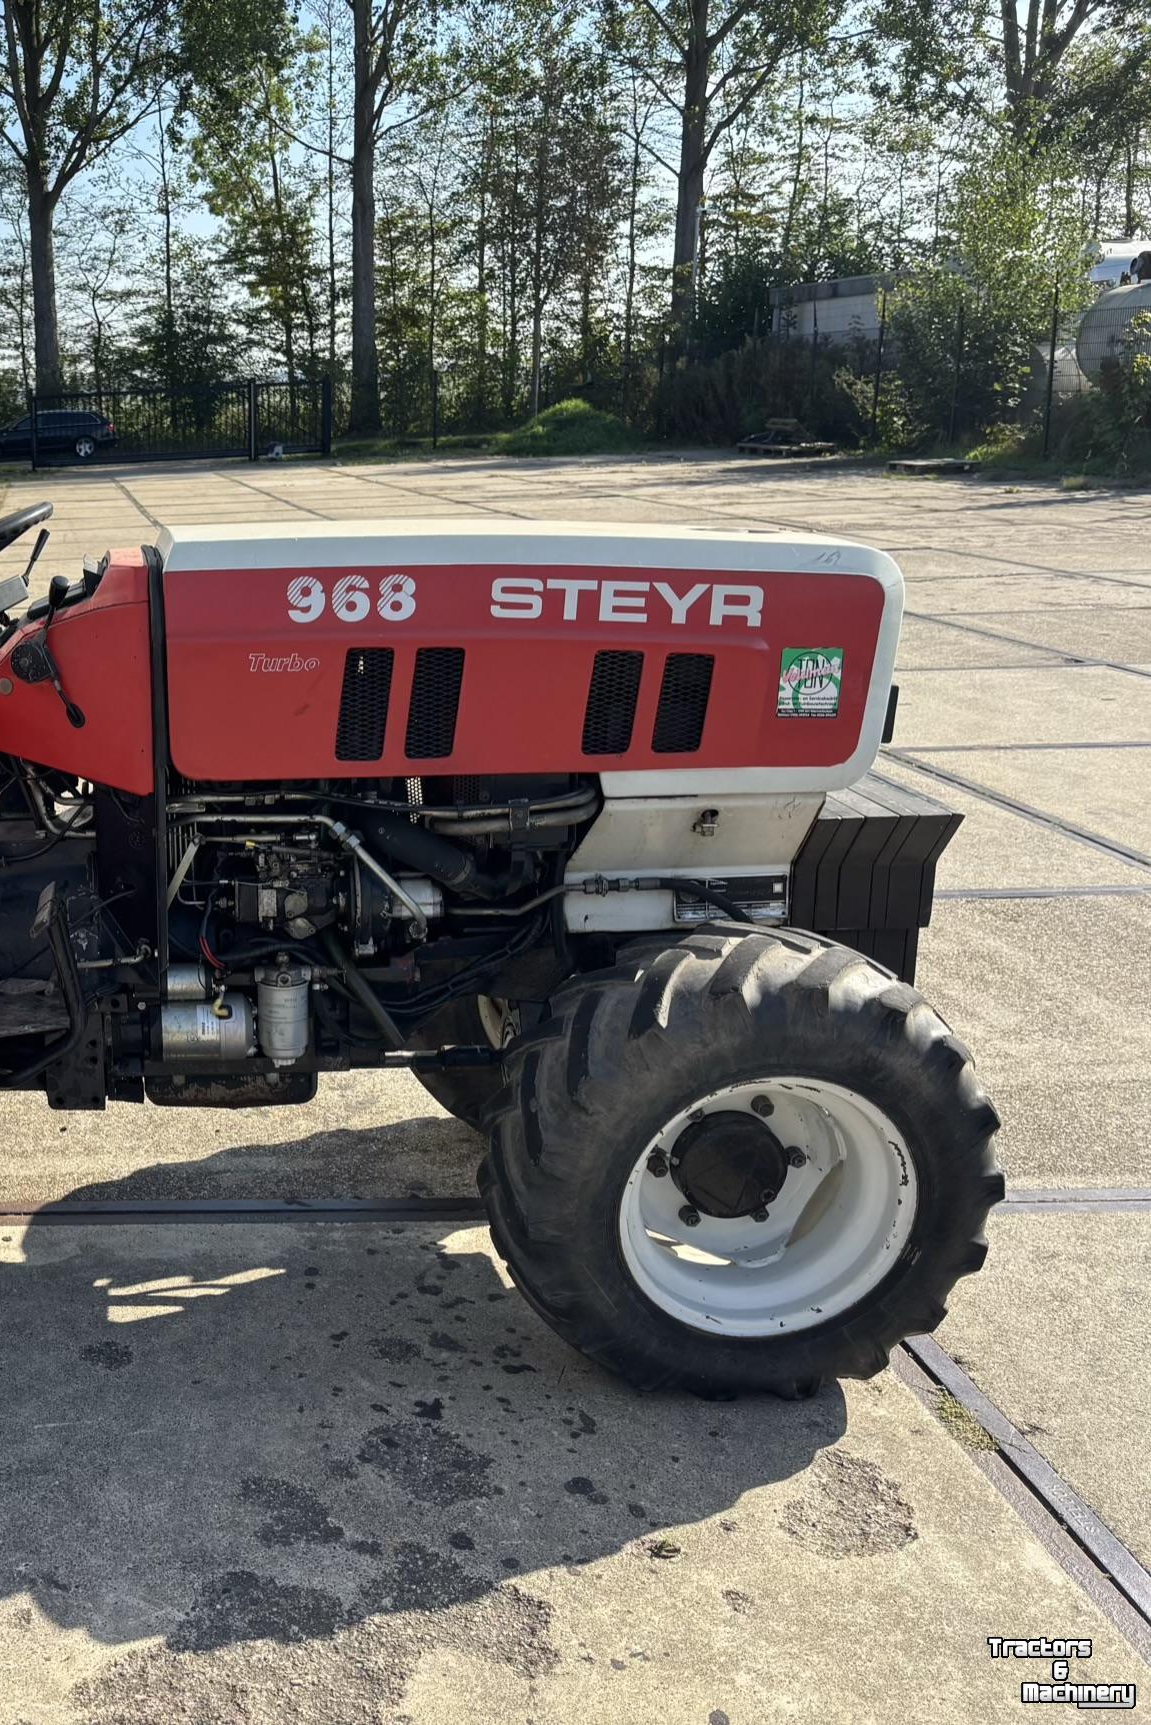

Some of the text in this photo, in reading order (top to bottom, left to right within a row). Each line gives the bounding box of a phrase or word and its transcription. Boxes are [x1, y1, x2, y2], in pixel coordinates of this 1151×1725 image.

[287, 574, 416, 624] 968
[490, 577, 765, 627] STEYR
[248, 652, 321, 672] Turbo
